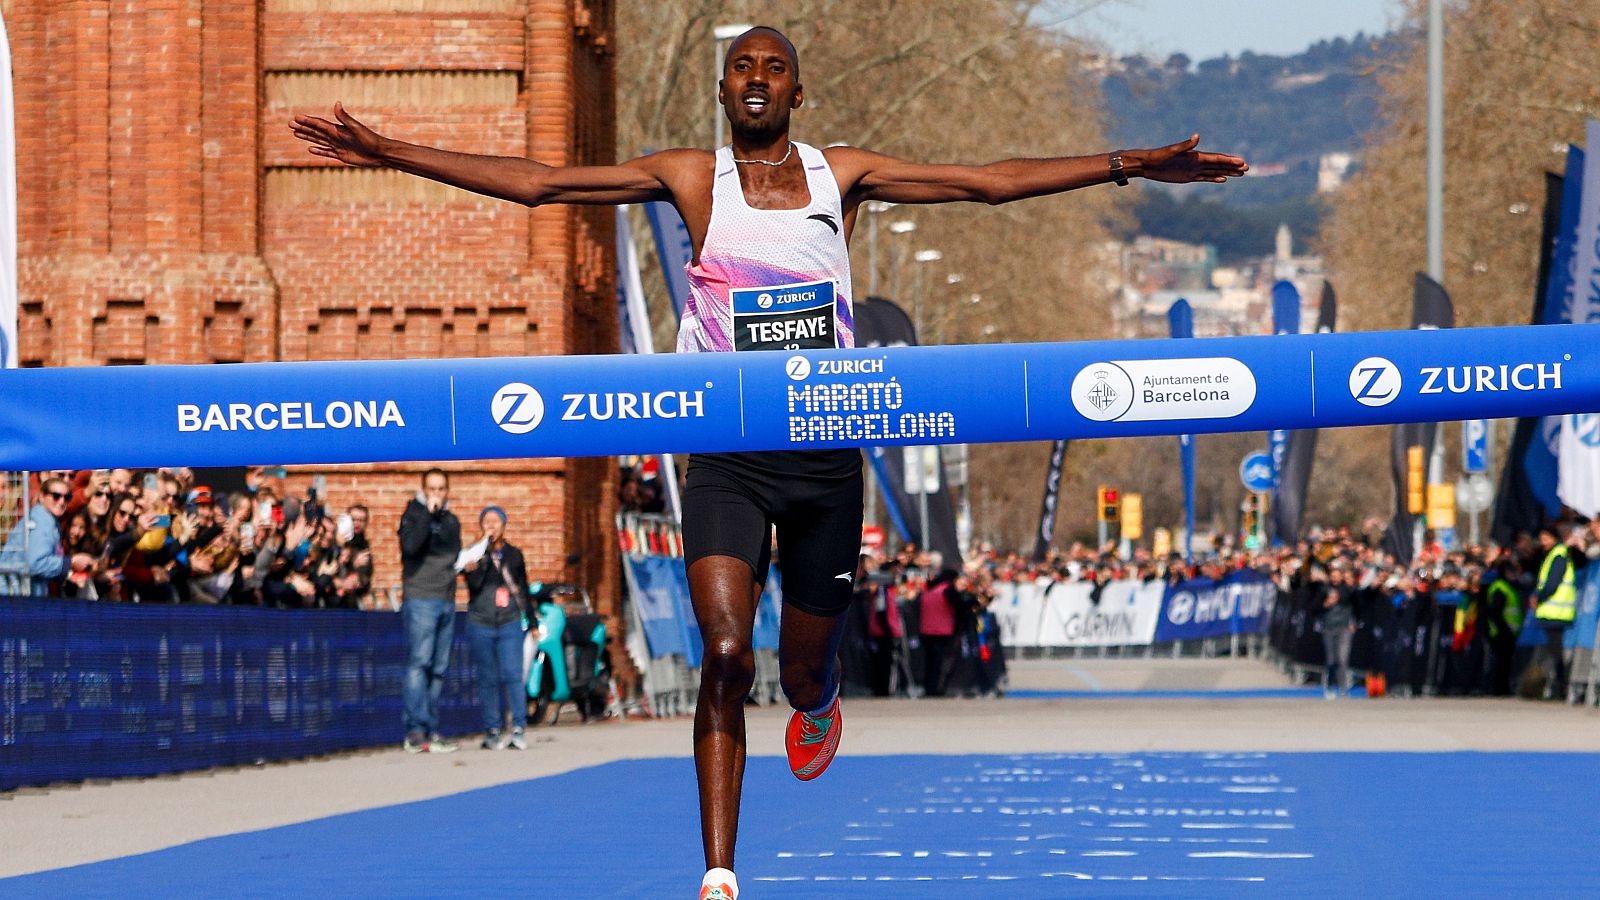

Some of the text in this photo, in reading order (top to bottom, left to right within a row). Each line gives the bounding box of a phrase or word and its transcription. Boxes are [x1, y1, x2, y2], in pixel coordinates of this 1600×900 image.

[746, 315, 827, 343] TESFAYE
[787, 376, 903, 412] MARATÓ
[1143, 373, 1229, 388] Ajuntament de
[1143, 389, 1230, 403] Barcelona
[177, 400, 405, 432] BARCELONA
[788, 411, 955, 442] BARCELONA
